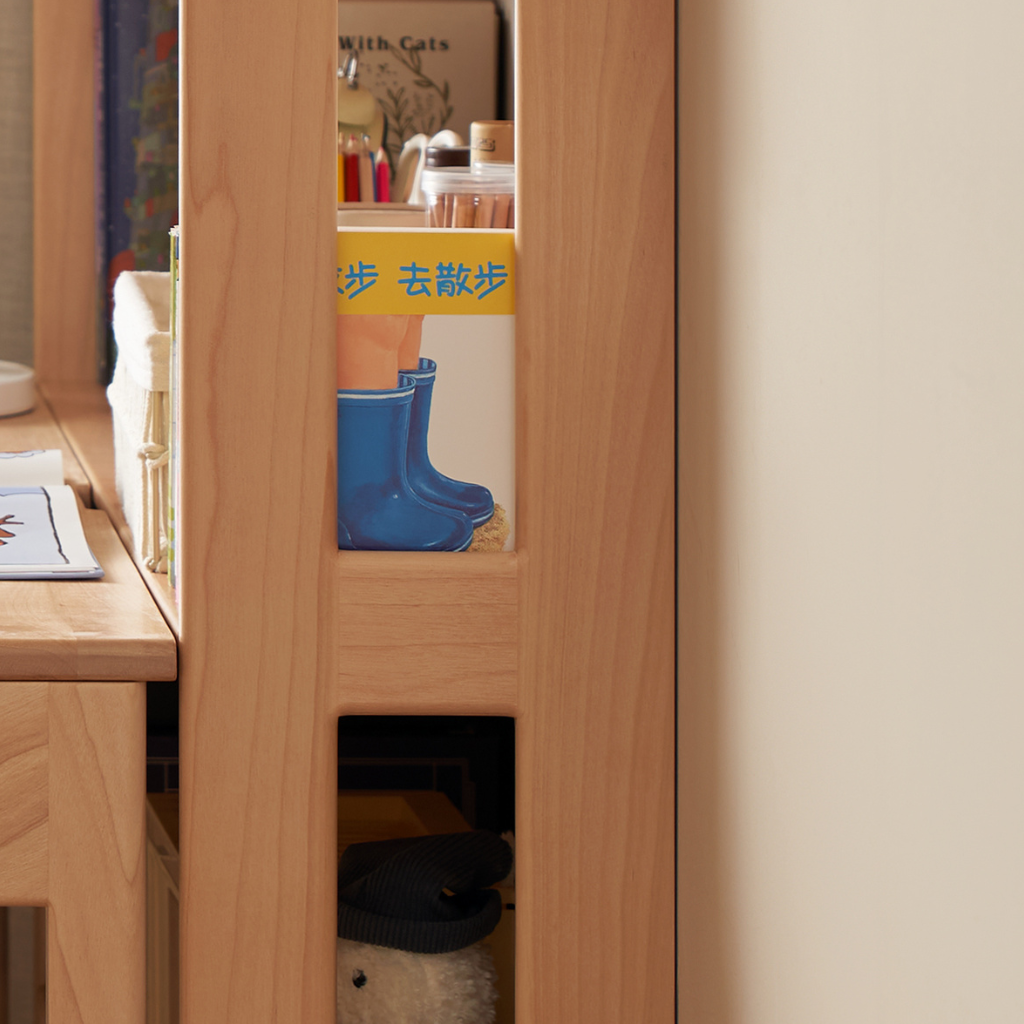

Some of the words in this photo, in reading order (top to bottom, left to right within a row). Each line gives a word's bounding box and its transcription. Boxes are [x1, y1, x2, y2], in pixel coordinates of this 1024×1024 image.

[338, 35, 389, 51] With
[399, 35, 449, 51] Cats
[337, 261, 379, 300] 步
[397, 261, 509, 300] 去散步
